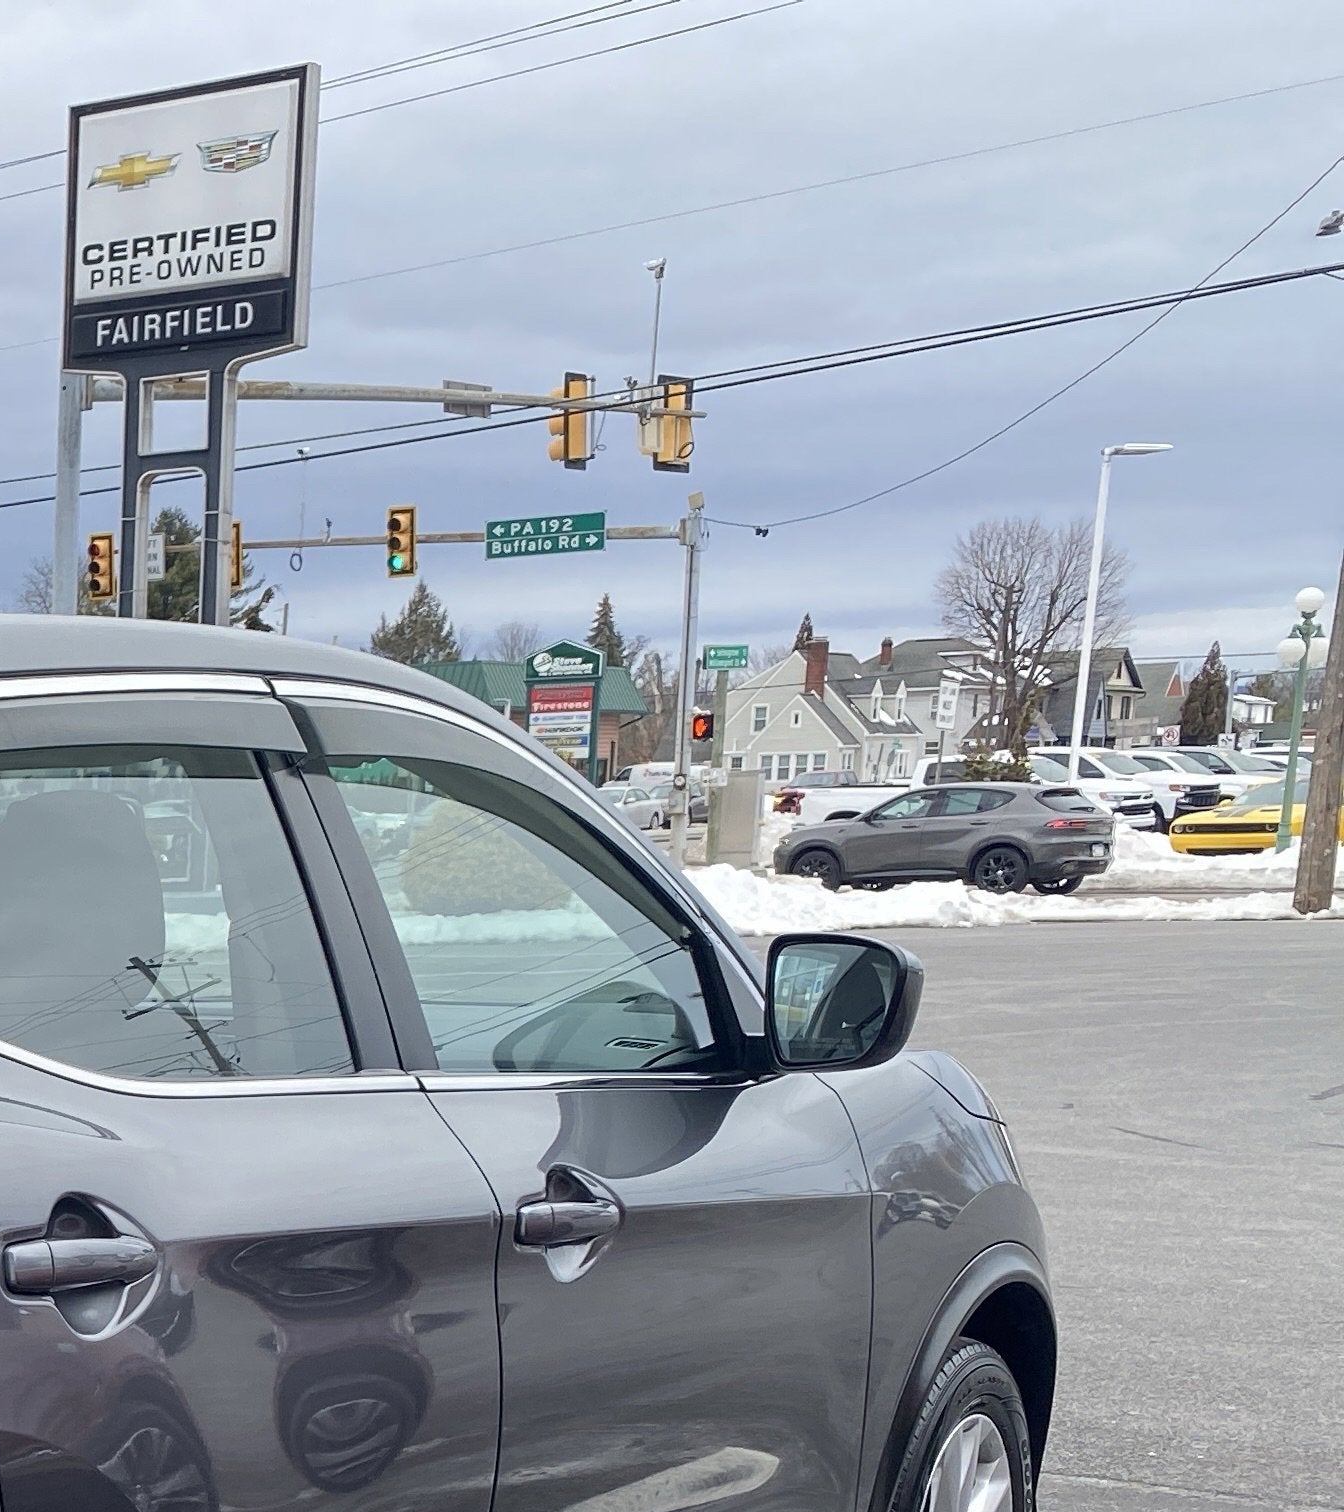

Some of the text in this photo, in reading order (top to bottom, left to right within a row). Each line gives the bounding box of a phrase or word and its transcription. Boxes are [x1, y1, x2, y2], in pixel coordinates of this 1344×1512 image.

[81, 218, 277, 266] CERTIFIED
[90, 247, 265, 290] PRE-OWNED
[96, 301, 255, 347] FAIRFIELD
[510, 518, 573, 536] PA 192
[491, 534, 580, 555] Buffalo Rd
[531, 701, 590, 713] Firestone
